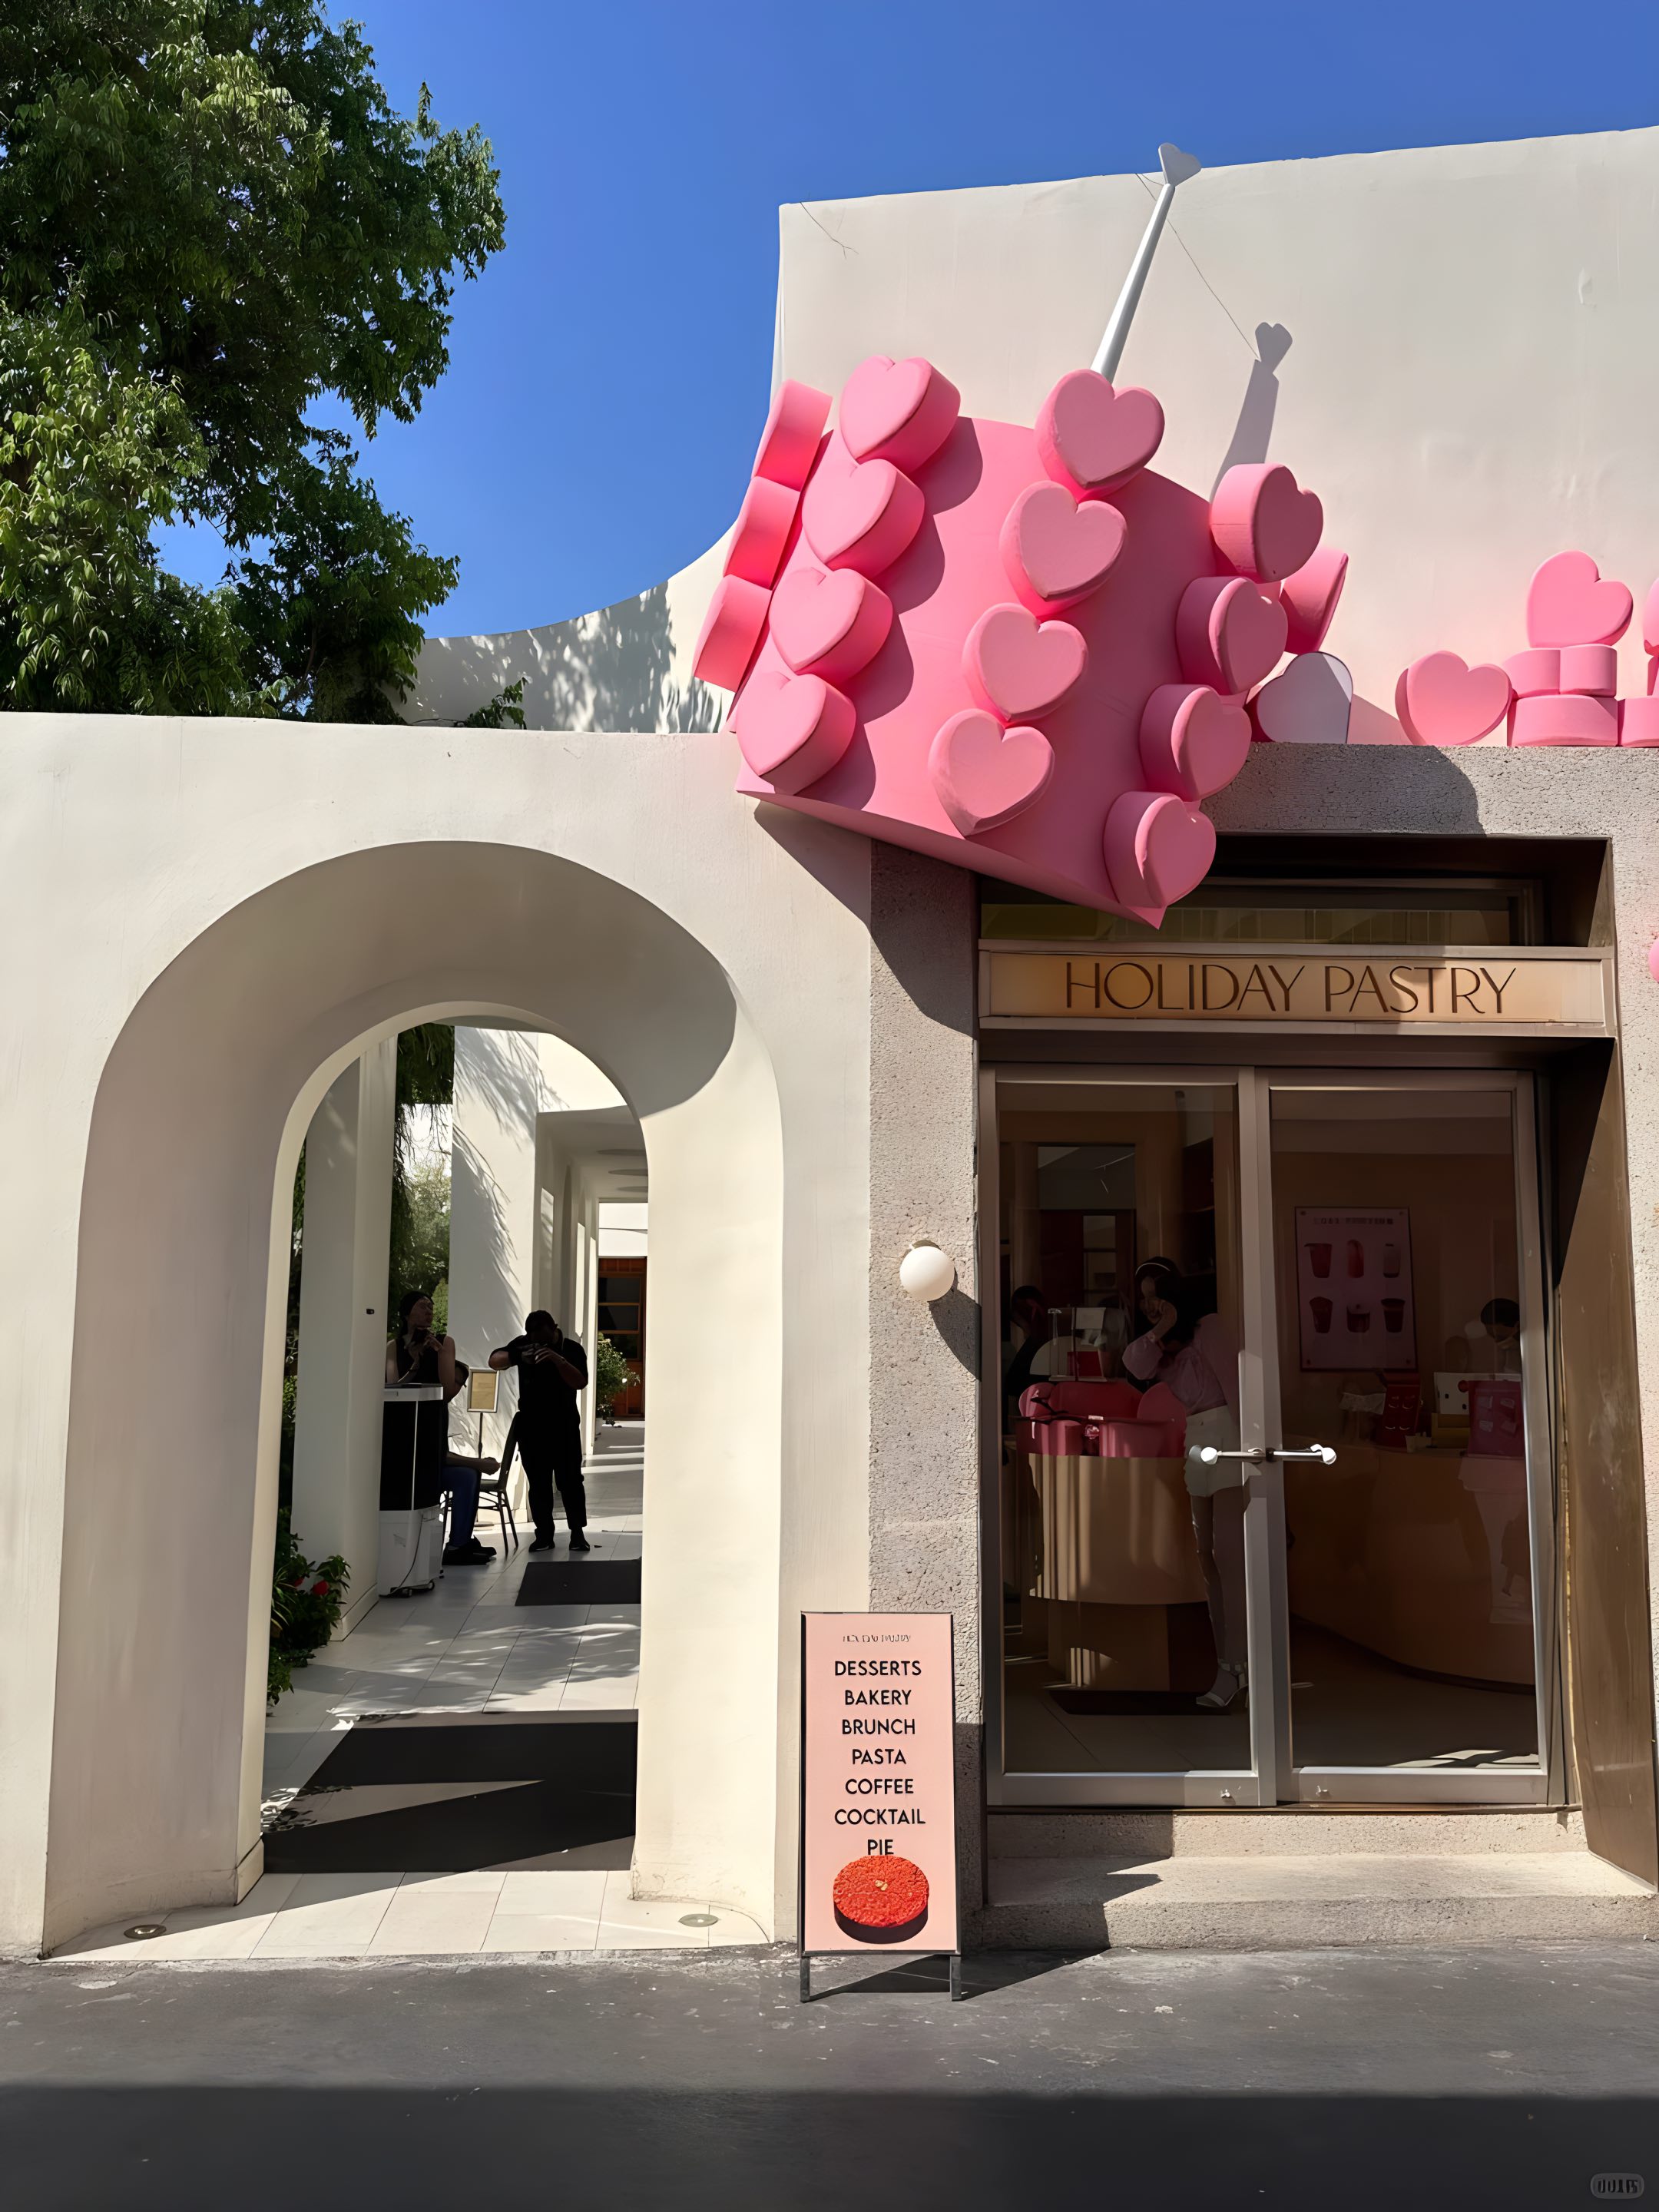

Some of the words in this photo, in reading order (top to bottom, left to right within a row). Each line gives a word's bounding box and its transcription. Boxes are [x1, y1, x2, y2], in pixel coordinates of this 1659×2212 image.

[1065, 961, 1306, 1012] HOLIDAY
[1324, 964, 1518, 1015] PASTRY
[834, 1660, 922, 1677] DESSERTS
[844, 1689, 912, 1706] BAKERY
[842, 1718, 916, 1735] BRUNCH
[852, 1748, 907, 1765] PASTA
[845, 1778, 914, 1795] COFFEE
[834, 1808, 926, 1826] COCKTAIL
[867, 1839, 895, 1856] PIE
